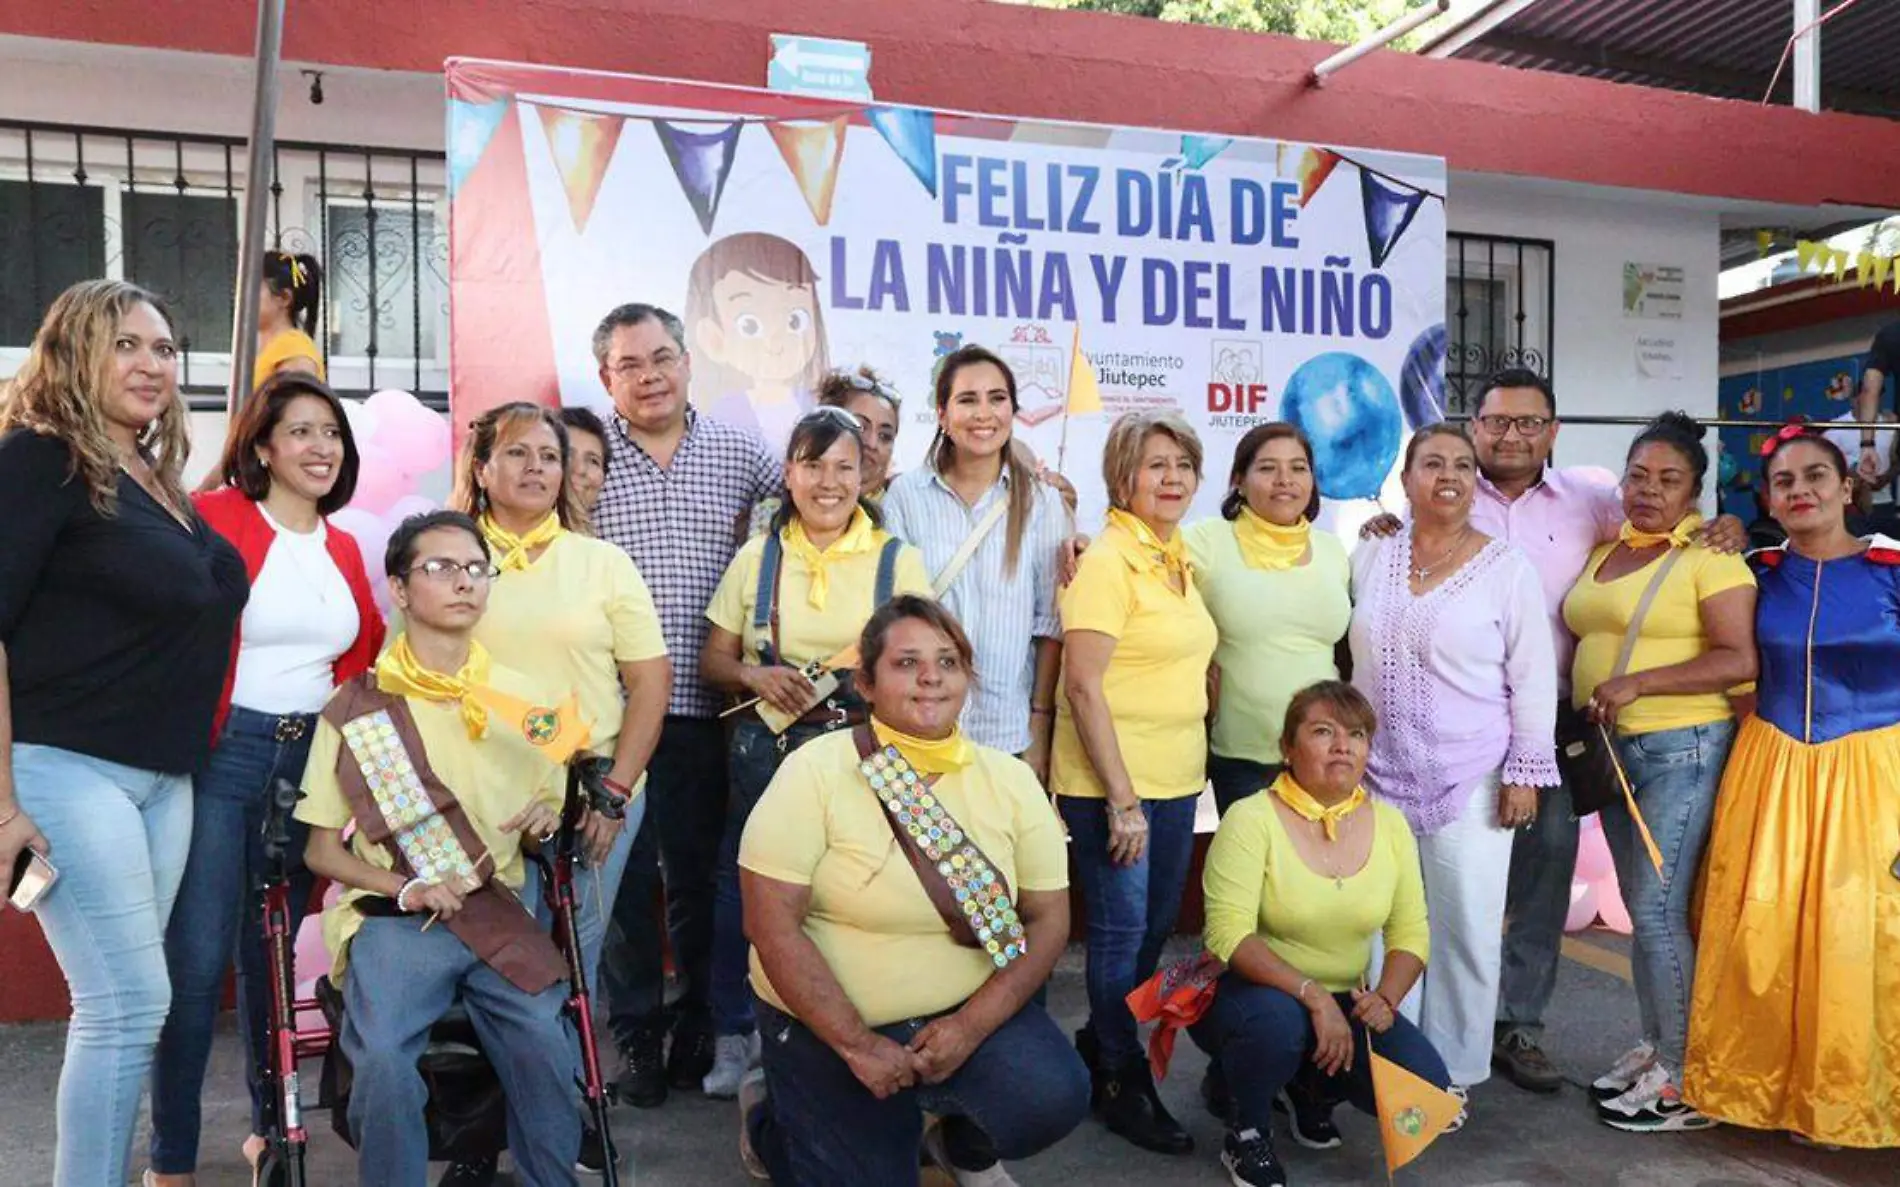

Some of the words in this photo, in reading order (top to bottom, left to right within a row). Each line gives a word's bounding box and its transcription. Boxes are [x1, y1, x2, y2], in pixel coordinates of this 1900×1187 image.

[942, 153, 1100, 234] FELIZ
[1116, 158, 1216, 243] DÍA
[1230, 174, 1300, 249] DE
[829, 235, 911, 312] LA
[926, 232, 1078, 322] NIÑA
[1088, 254, 1127, 323] Y
[1142, 257, 1246, 330] DEL
[1260, 255, 1393, 340] NIÑO
[1085, 350, 1184, 369] yuntamiento
[1097, 367, 1167, 391] Jiutepec
[1208, 383, 1268, 414] DIF
